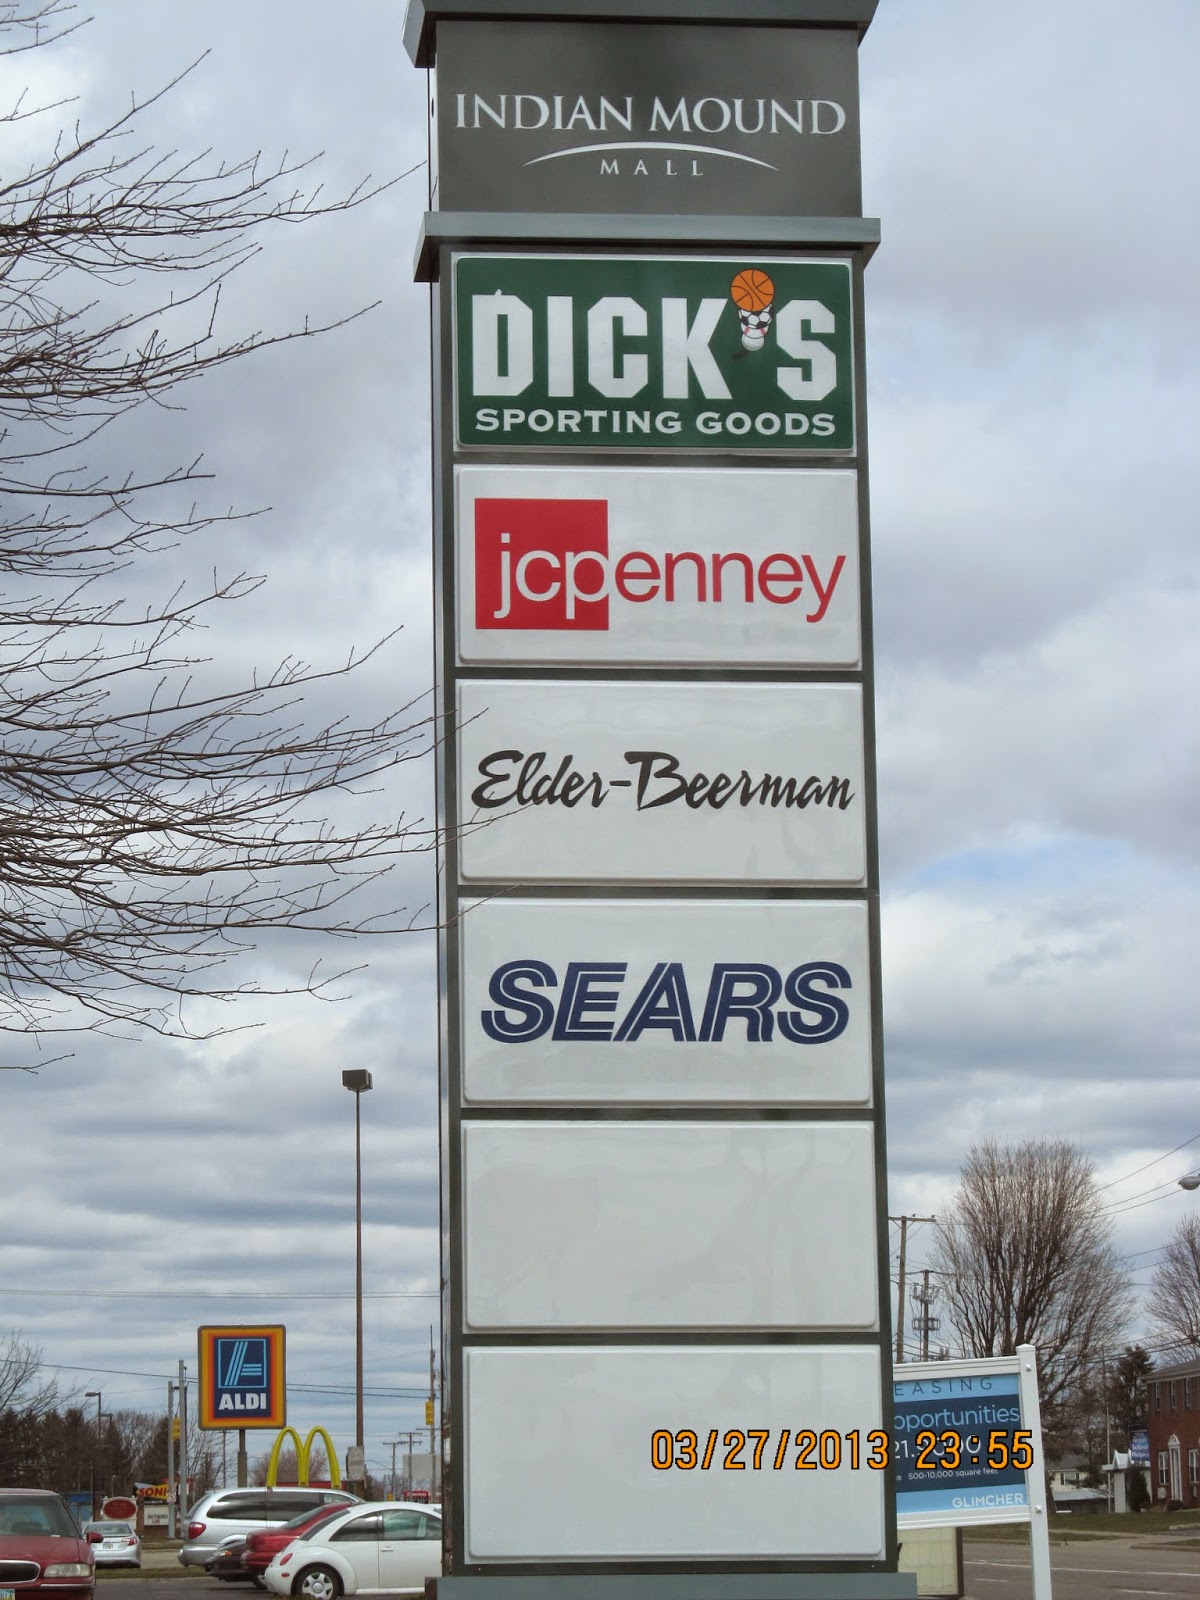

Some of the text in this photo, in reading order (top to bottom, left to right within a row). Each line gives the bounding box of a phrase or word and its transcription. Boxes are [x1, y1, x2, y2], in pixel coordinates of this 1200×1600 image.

[455, 93, 847, 135] INDIAN MOUND
[599, 158, 704, 177] MALL
[471, 269, 838, 401] DICK'S
[475, 408, 837, 436] SPORTING GOODS
[493, 532, 848, 624] jcpenney
[470, 748, 856, 812] Elder-Beerman
[480, 959, 853, 1046] SEARS
[218, 1393, 267, 1411] ALDI
[908, 1469, 954, 1481] 500-10,000
[955, 1468, 982, 1478] square
[138, 1487, 170, 1497] SONI
[952, 1493, 1024, 1508] GLIMCHER
